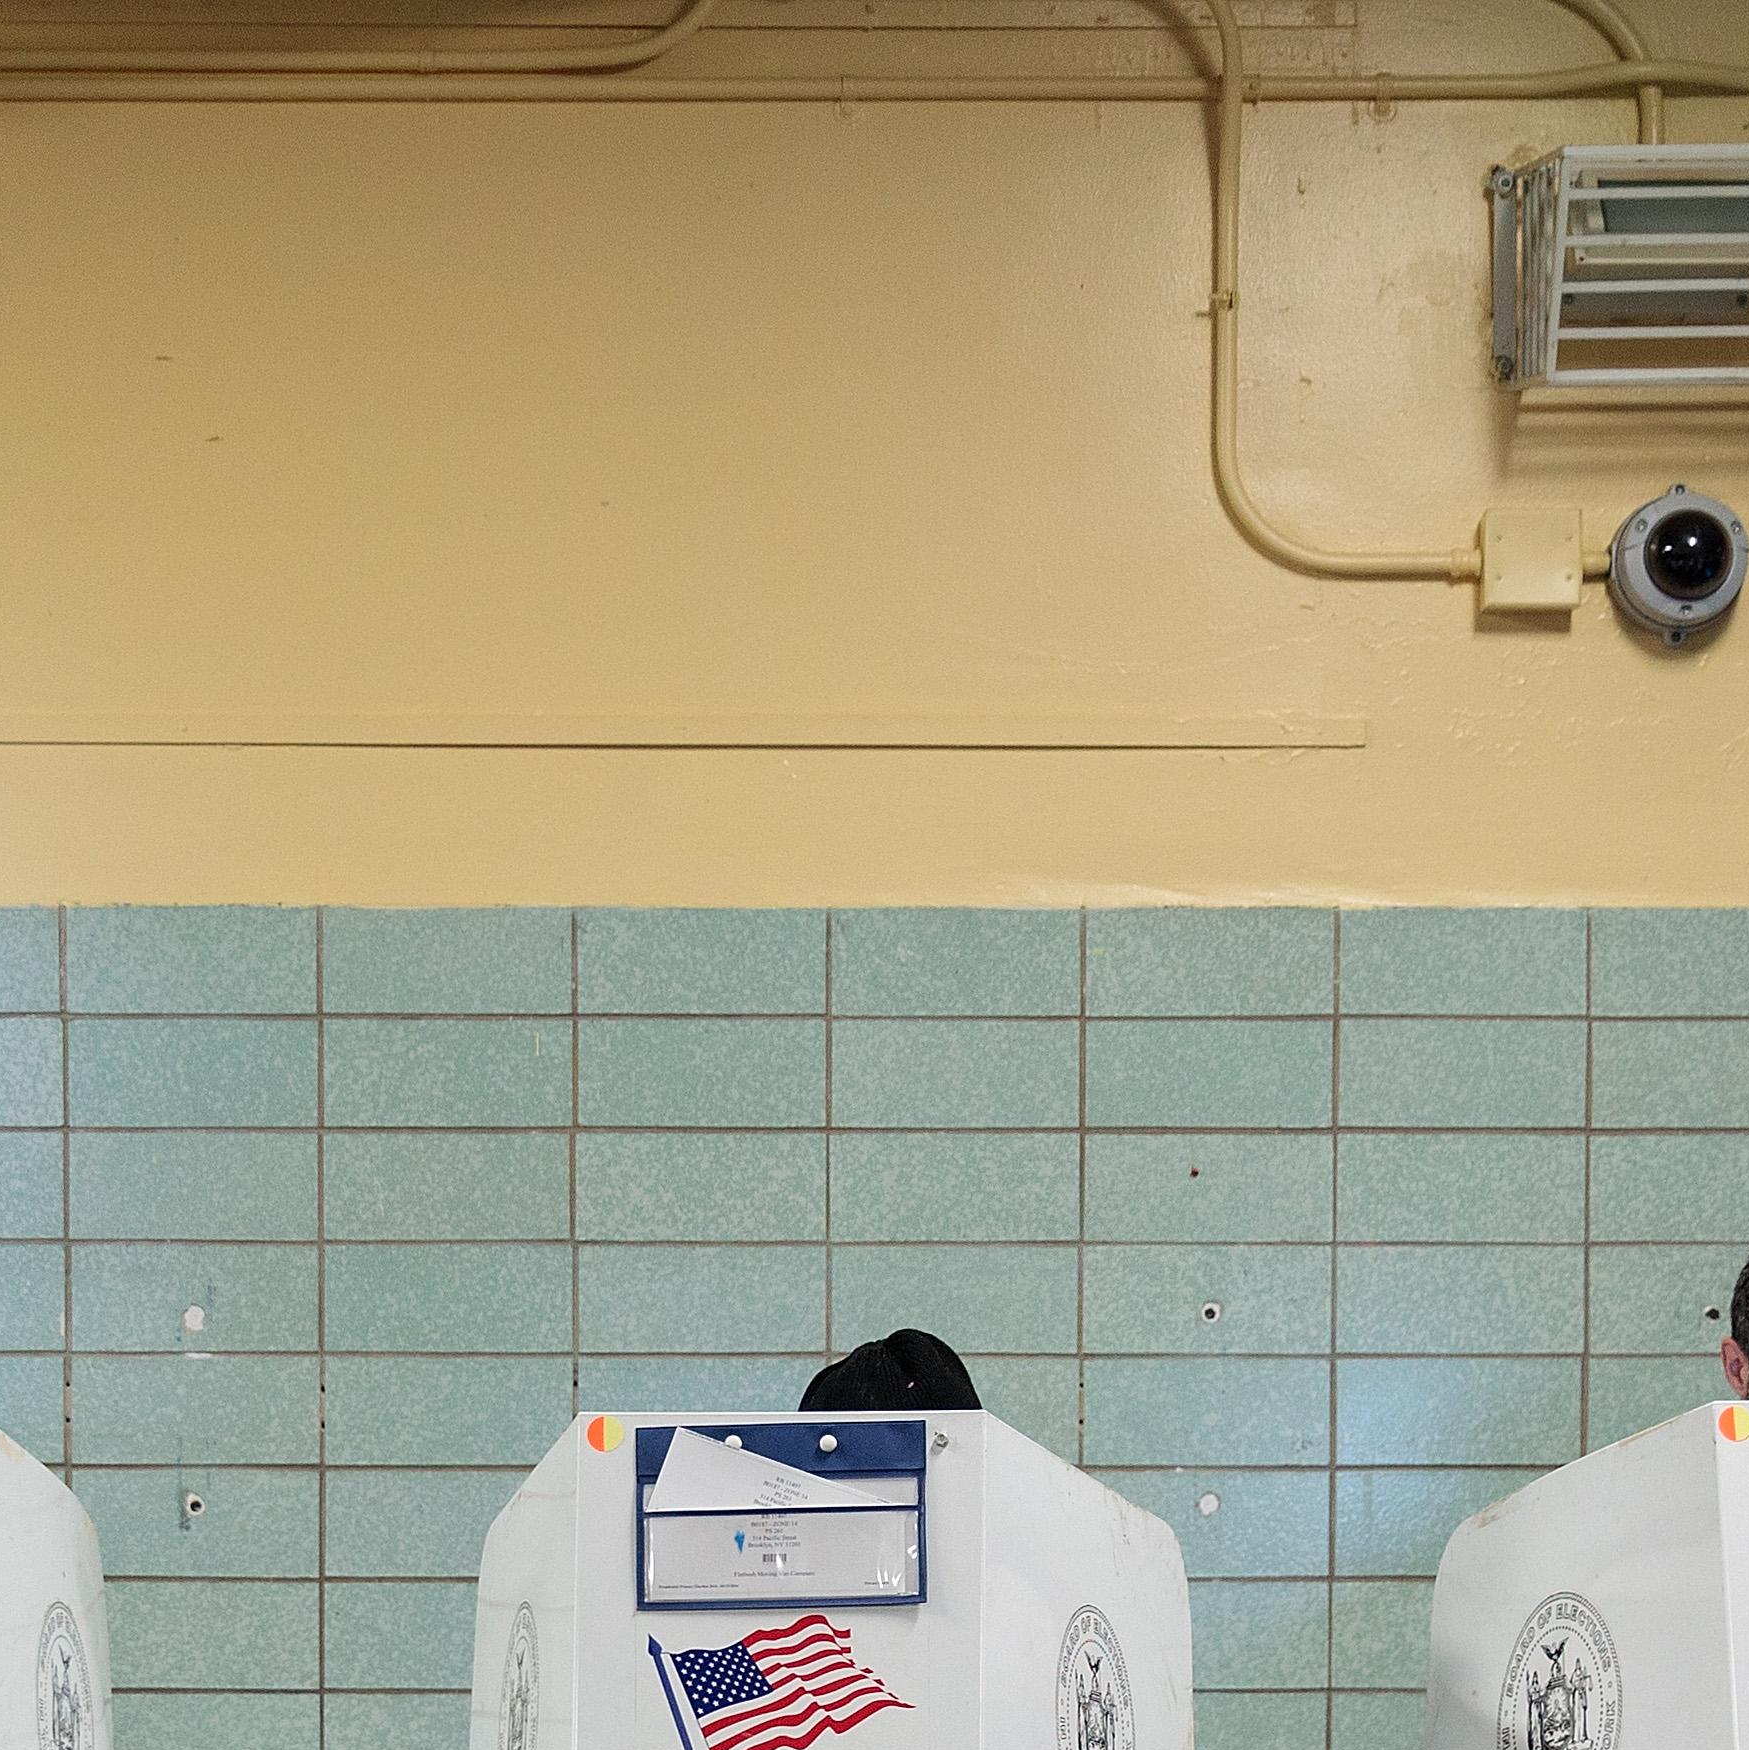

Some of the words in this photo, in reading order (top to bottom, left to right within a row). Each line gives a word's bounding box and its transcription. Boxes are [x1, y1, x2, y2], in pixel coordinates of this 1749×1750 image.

[1506, 1626, 1535, 1699] BOARD
[1536, 1604, 1553, 1630] OF
[1555, 1602, 1613, 1674] ELECTIONS
